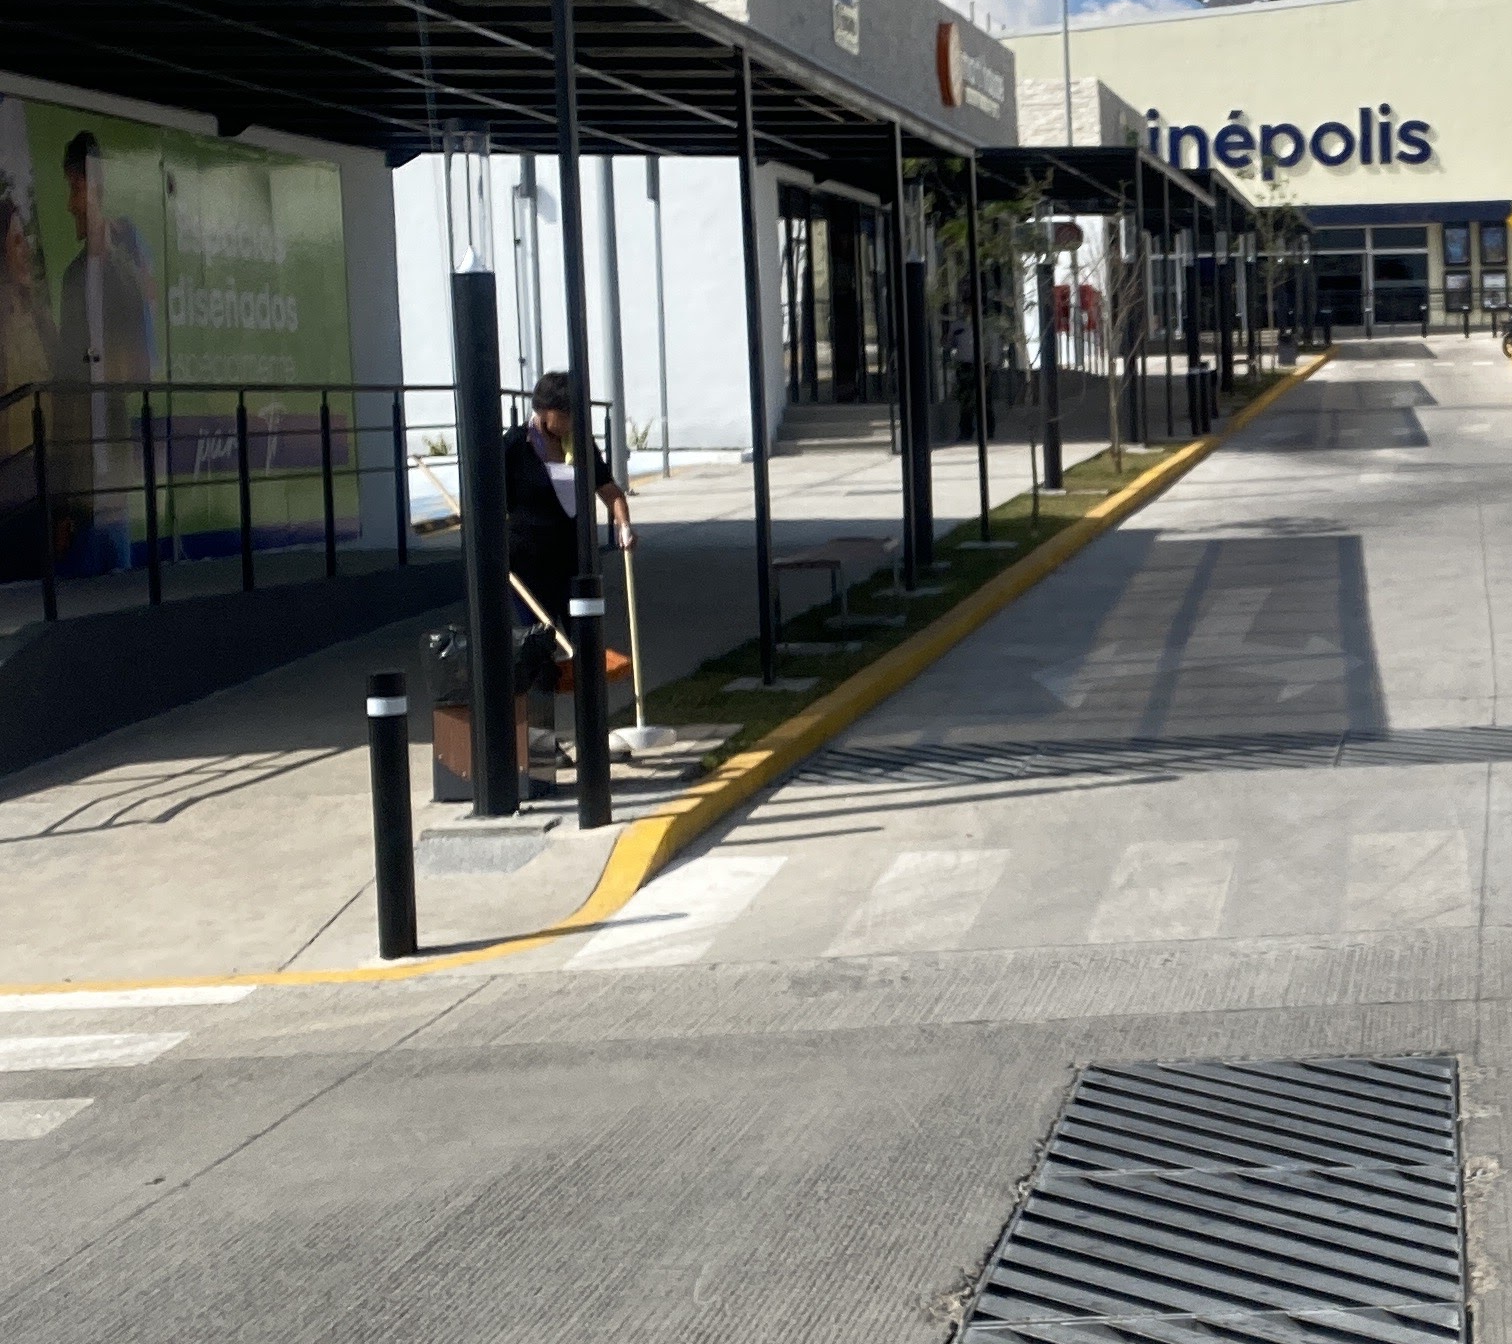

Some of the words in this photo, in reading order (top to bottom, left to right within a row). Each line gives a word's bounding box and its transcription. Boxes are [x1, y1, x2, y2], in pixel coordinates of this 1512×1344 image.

[1146, 102, 1432, 182] inépolis
[168, 274, 299, 333] diseñados
[193, 427, 242, 481] par
